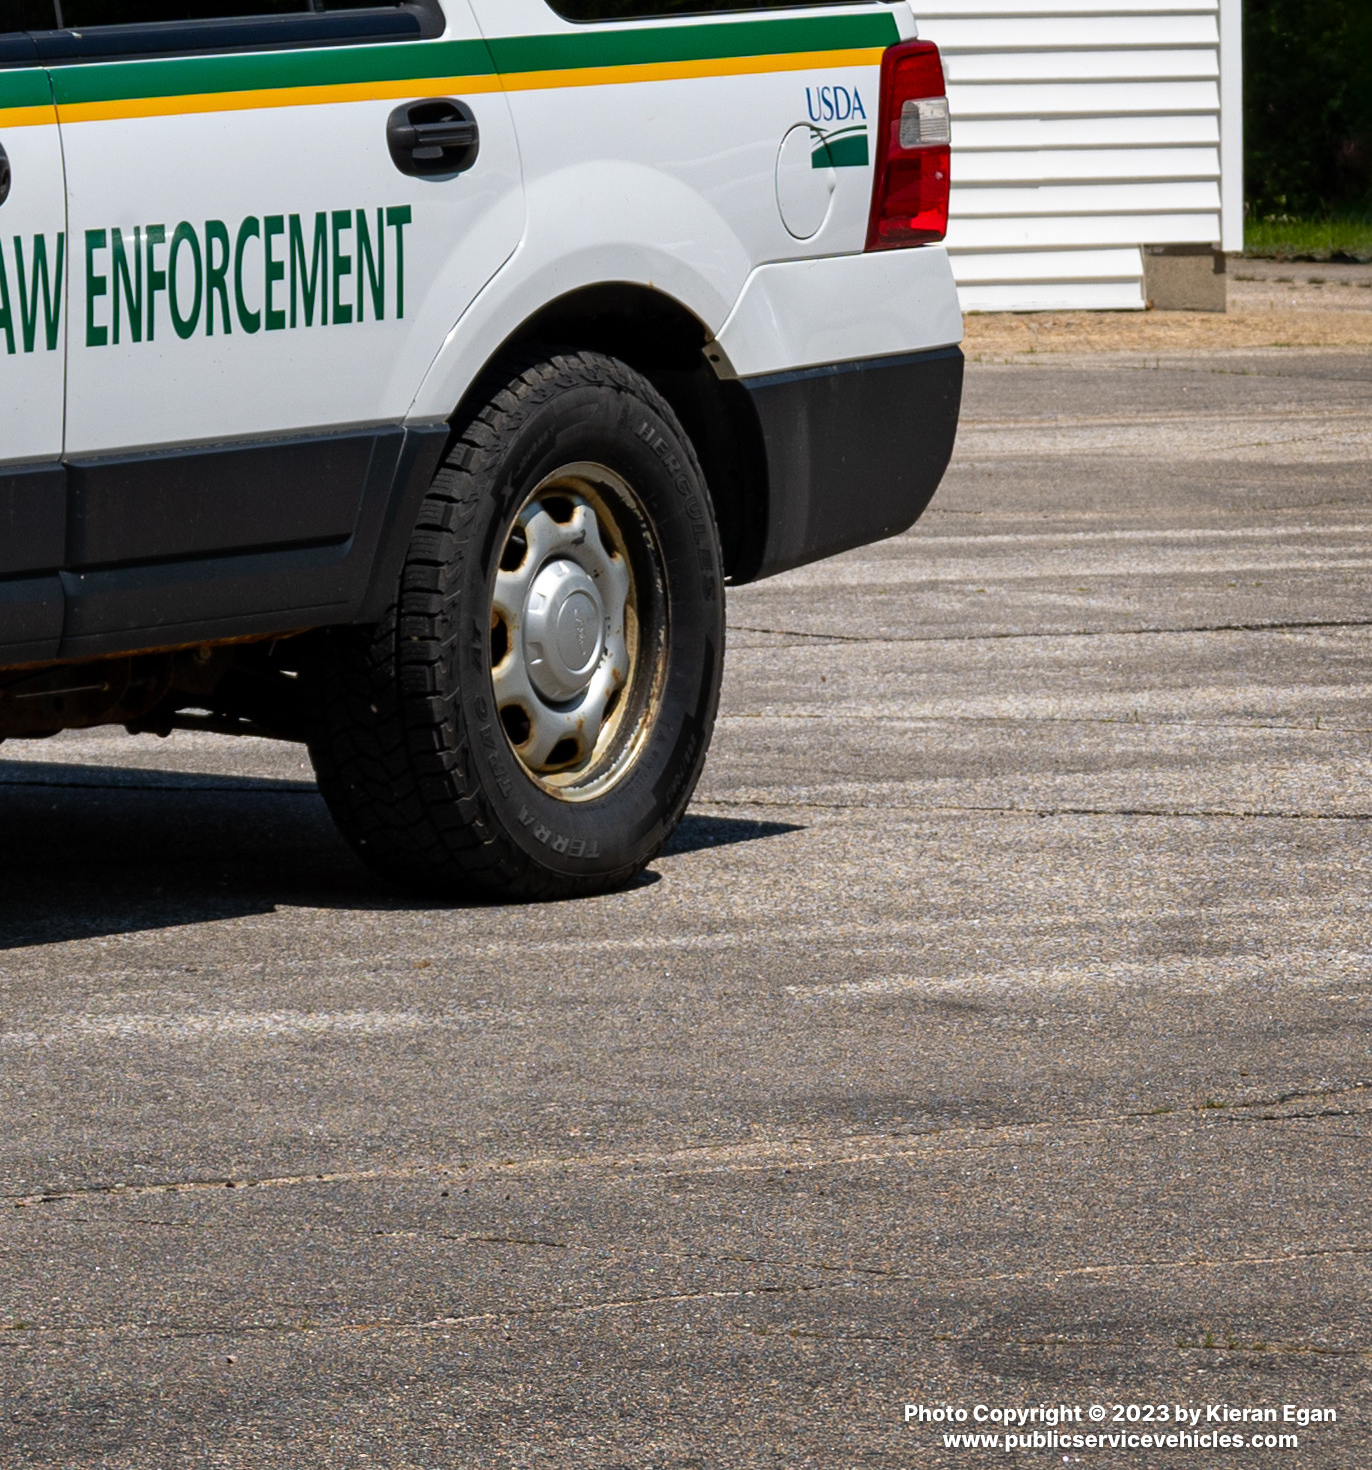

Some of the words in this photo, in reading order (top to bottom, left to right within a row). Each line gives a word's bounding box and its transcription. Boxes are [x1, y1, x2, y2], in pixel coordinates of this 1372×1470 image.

[805, 86, 867, 122] USDA
[84, 204, 412, 348] ENFORCEMENT
[518, 804, 600, 859] TERRA
